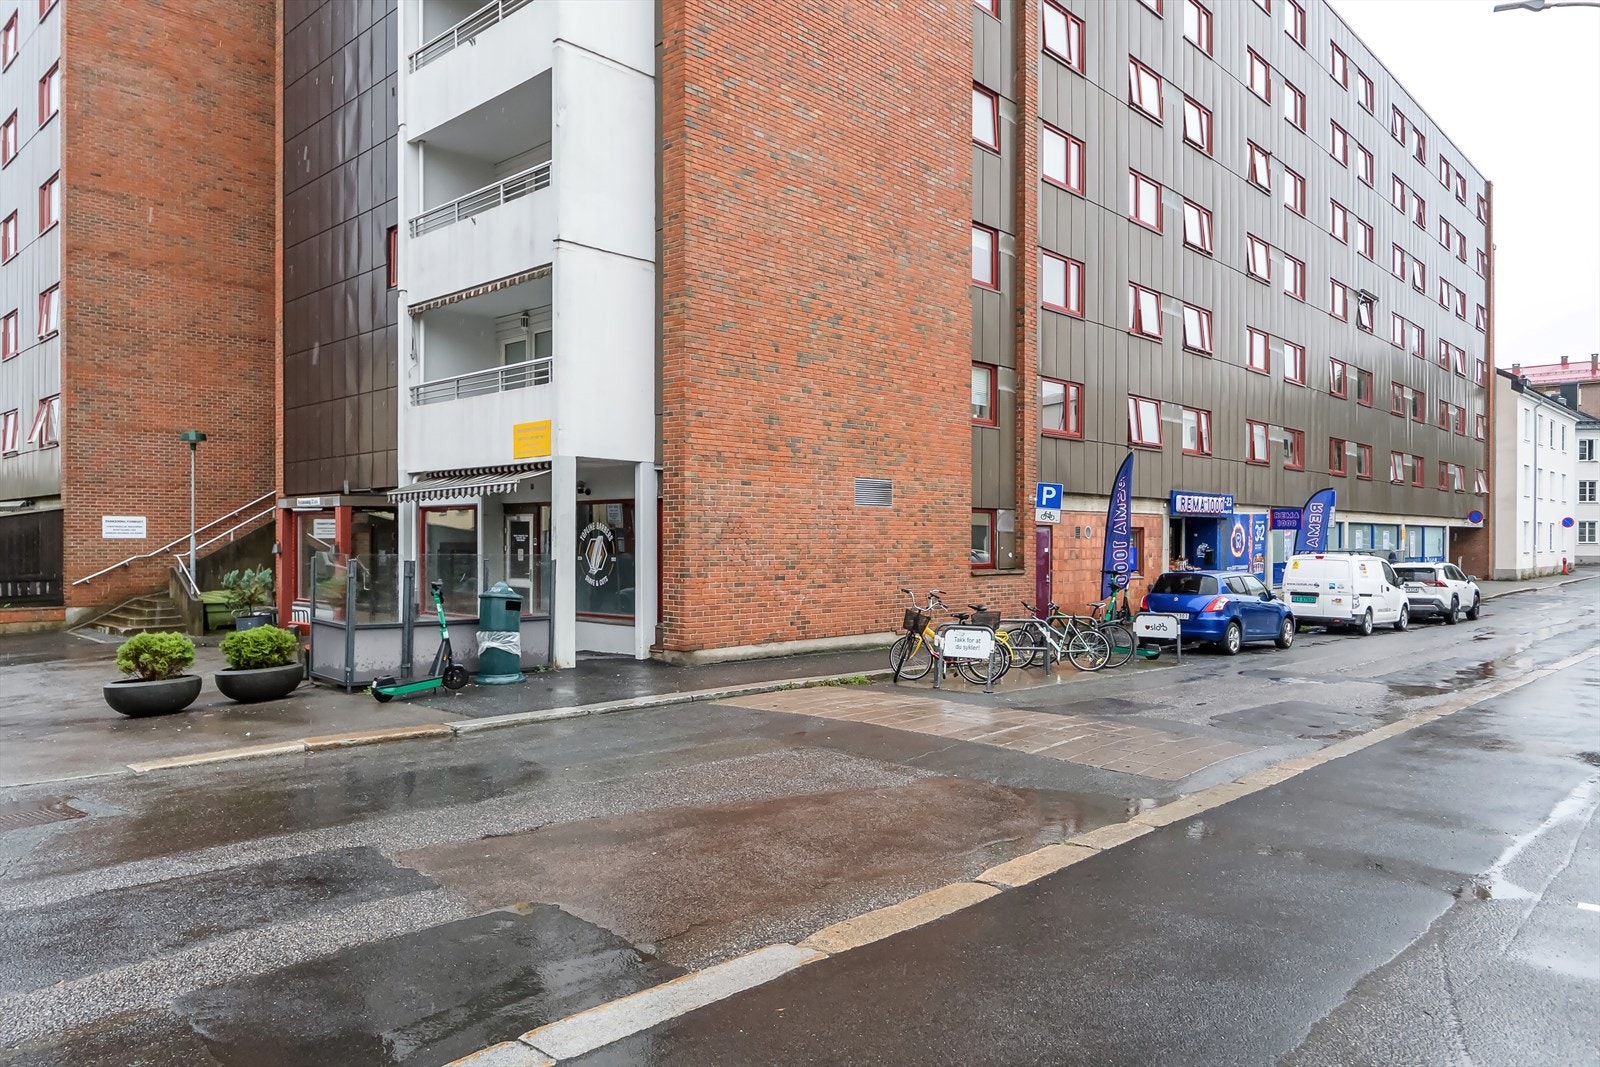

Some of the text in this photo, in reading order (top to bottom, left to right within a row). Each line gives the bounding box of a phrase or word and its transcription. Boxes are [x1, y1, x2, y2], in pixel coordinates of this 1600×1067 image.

[1042, 486, 1057, 506] P
[1180, 496, 1225, 514] REMA 1000
[1273, 511, 1300, 519] REMA
[1277, 519, 1297, 528] 1000
[580, 522, 613, 541] TOPLINE BARBERS
[599, 575, 609, 586] CUTS
